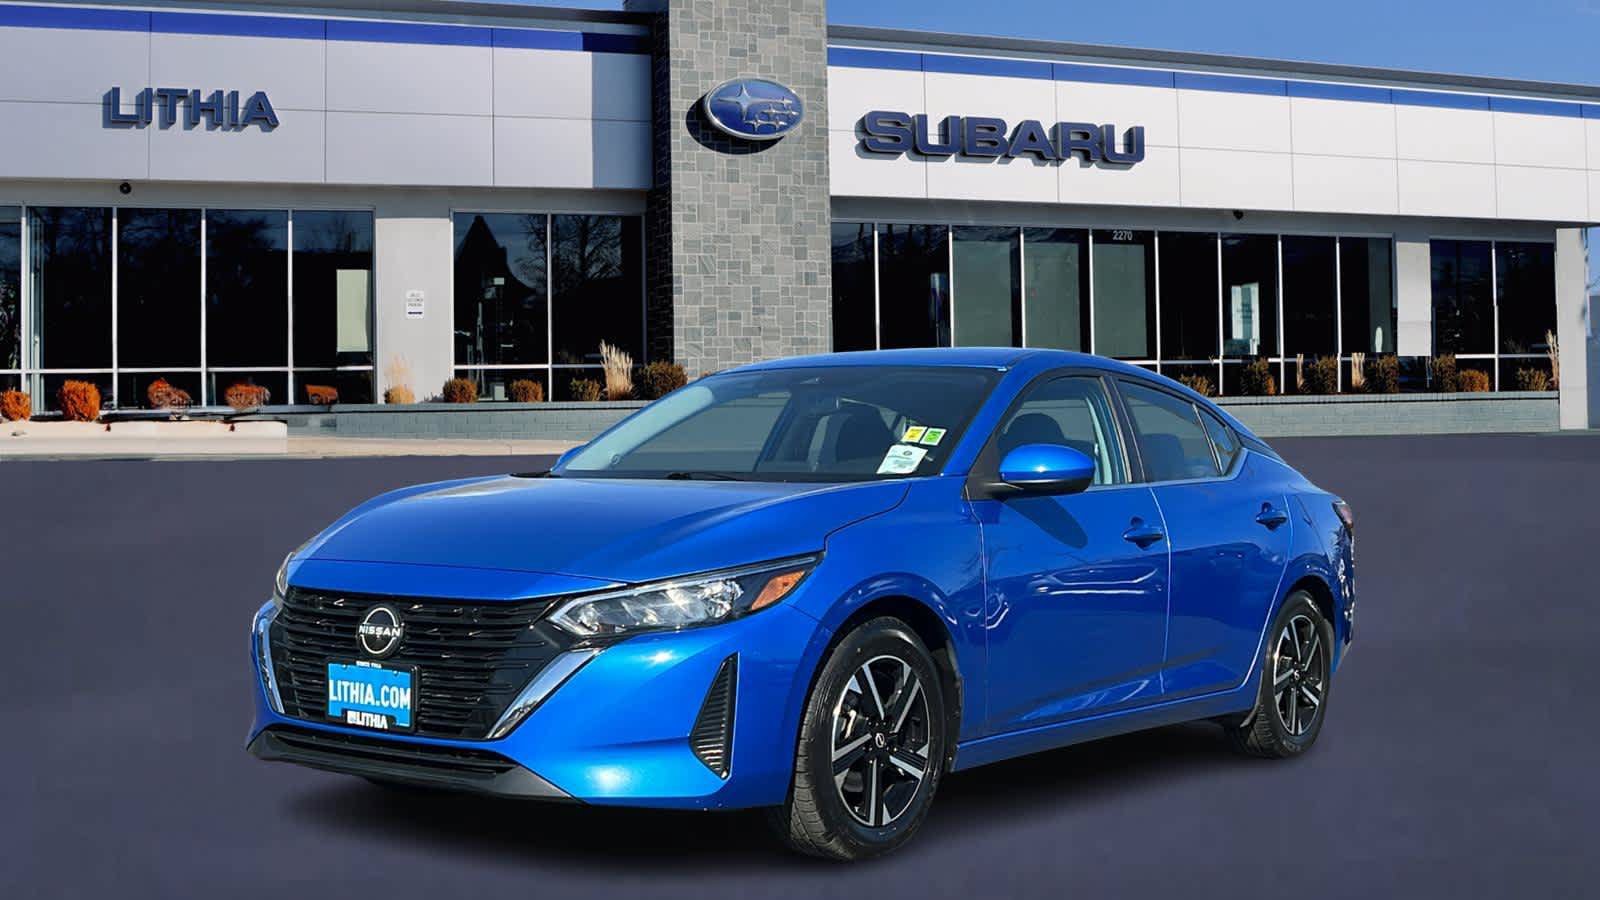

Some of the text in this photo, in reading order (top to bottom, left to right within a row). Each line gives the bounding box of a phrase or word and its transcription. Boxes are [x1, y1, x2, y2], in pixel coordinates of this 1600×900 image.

[104, 87, 279, 130] LITHIA
[857, 110, 1145, 168] SUBARU
[1112, 230, 1133, 240] 2270
[359, 625, 401, 637] NISSAN
[329, 680, 411, 710] LITHIA.COM
[356, 711, 388, 729] LITHIA
